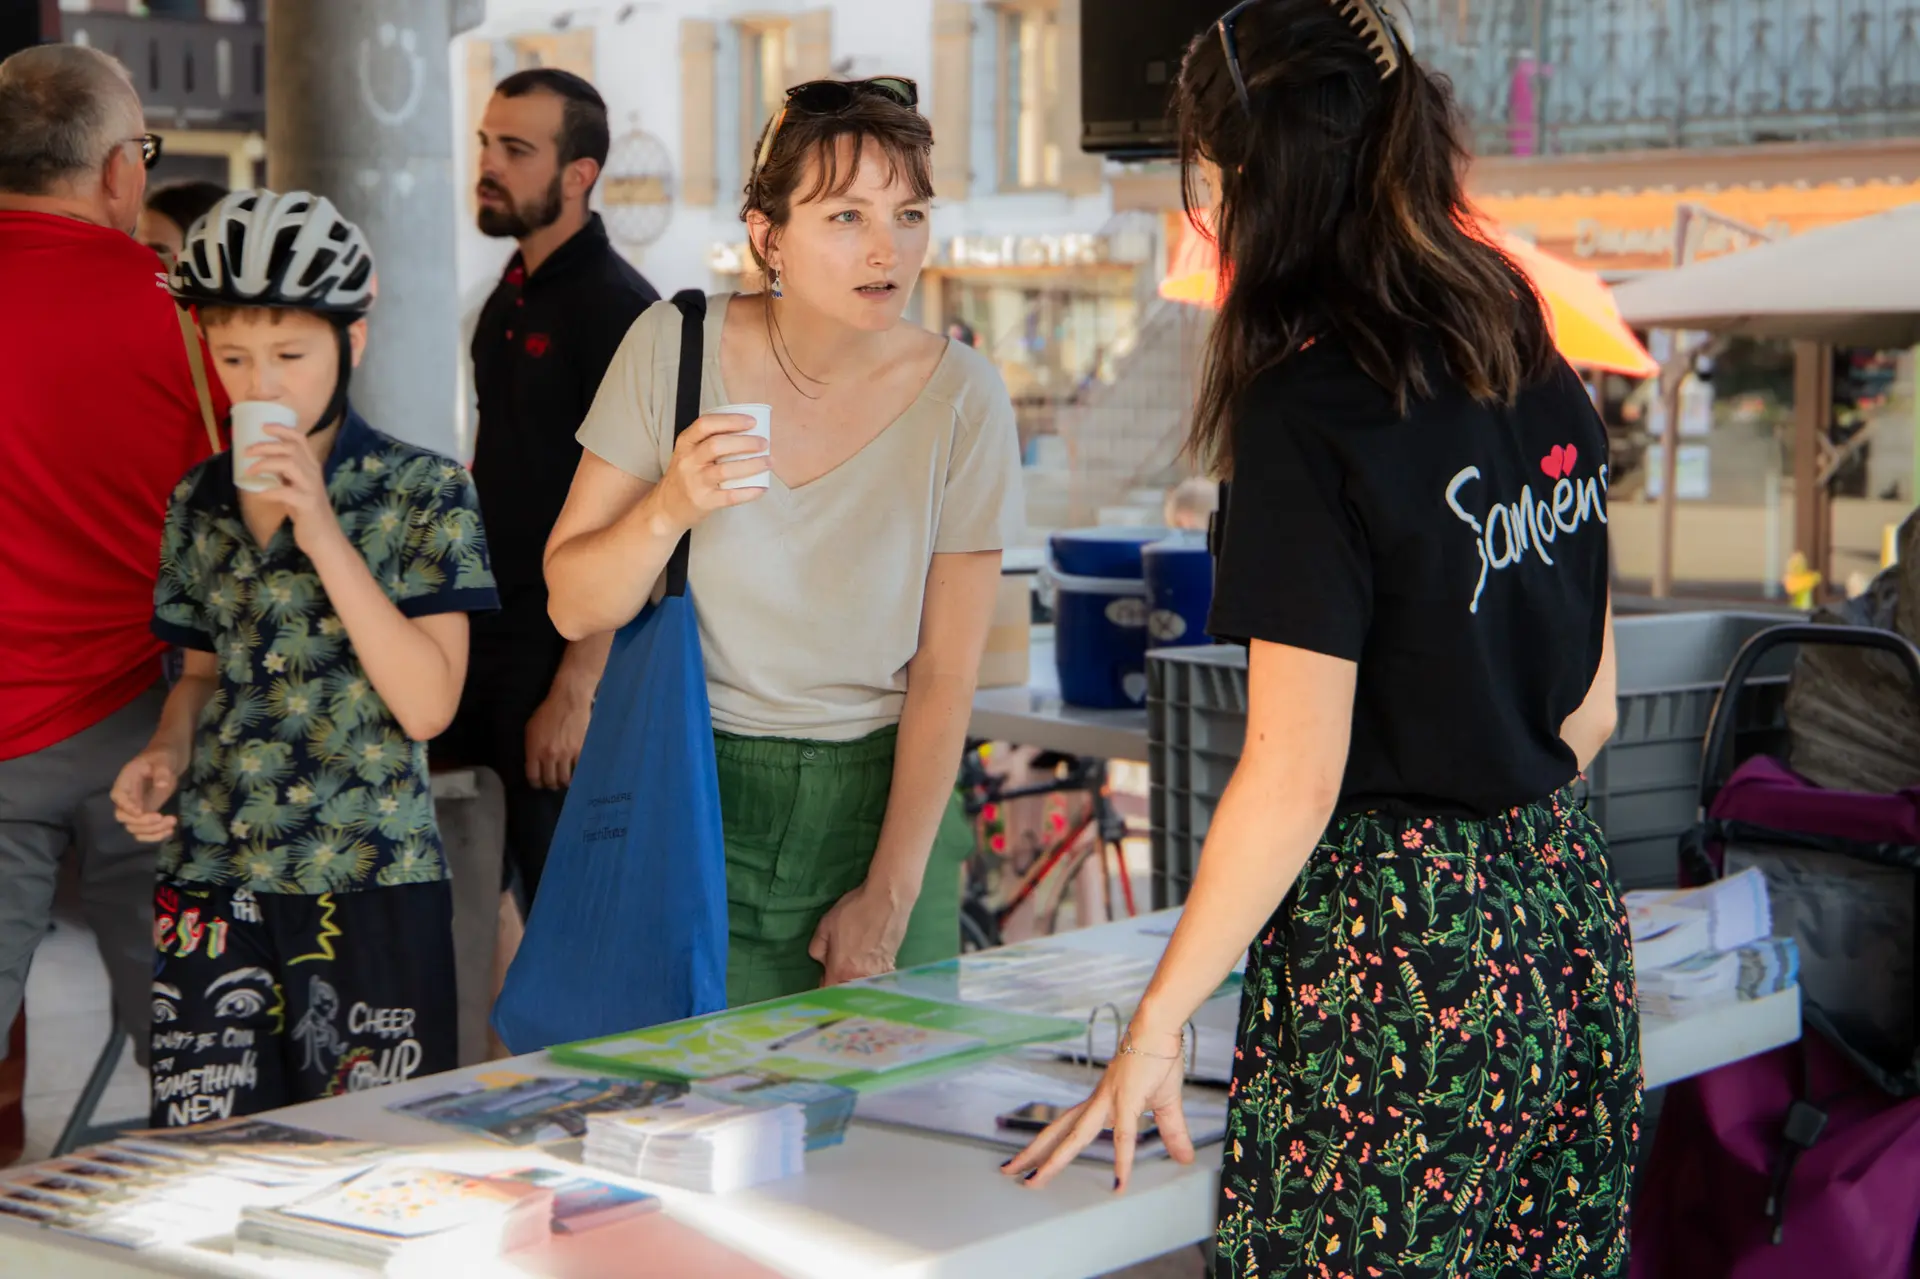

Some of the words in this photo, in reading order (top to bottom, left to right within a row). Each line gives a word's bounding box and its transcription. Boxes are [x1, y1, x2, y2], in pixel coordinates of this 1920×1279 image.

[348, 1001, 416, 1038] CHEER
[154, 1049, 258, 1102] SOMETHING
[379, 1039, 422, 1084] UP
[168, 1088, 235, 1126] NEW
